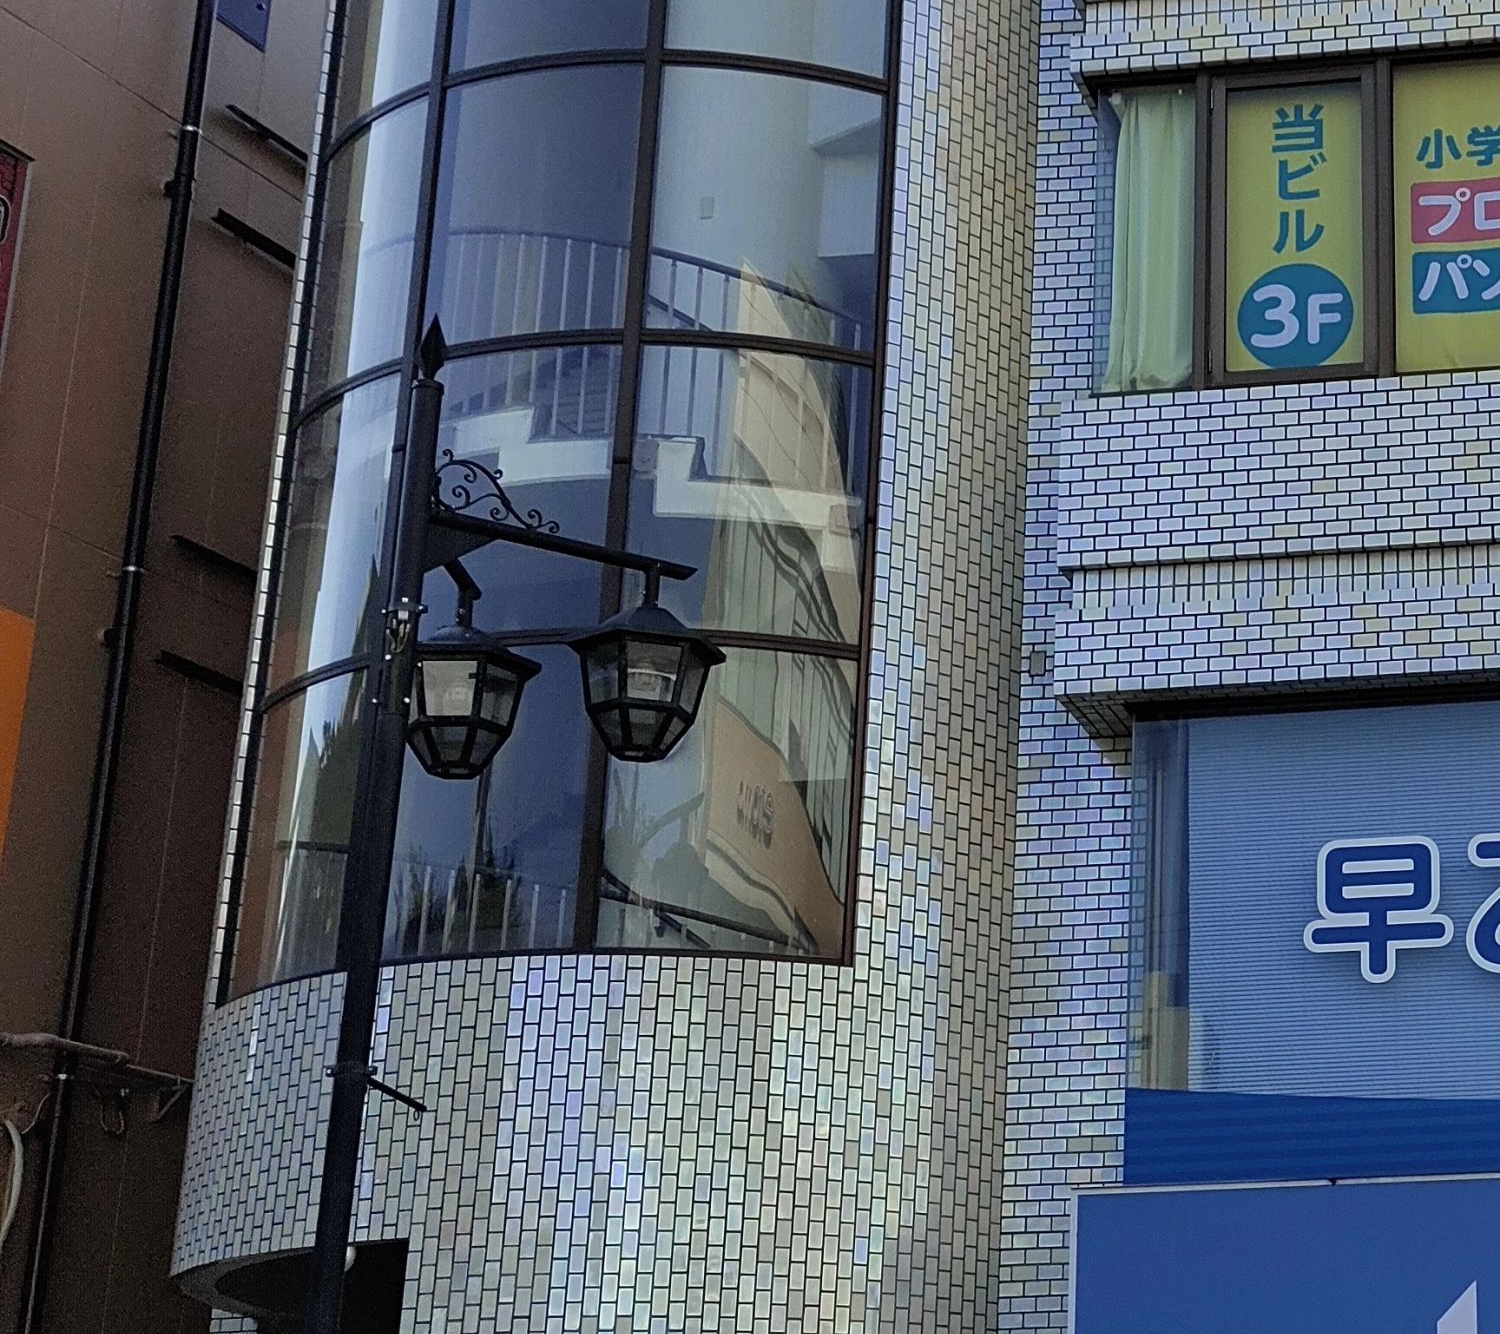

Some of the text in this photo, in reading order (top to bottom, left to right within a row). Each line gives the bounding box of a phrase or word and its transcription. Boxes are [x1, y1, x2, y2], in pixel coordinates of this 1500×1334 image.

[1273, 104, 1326, 254] 当ビル
[1250, 284, 1344, 349] 3F
